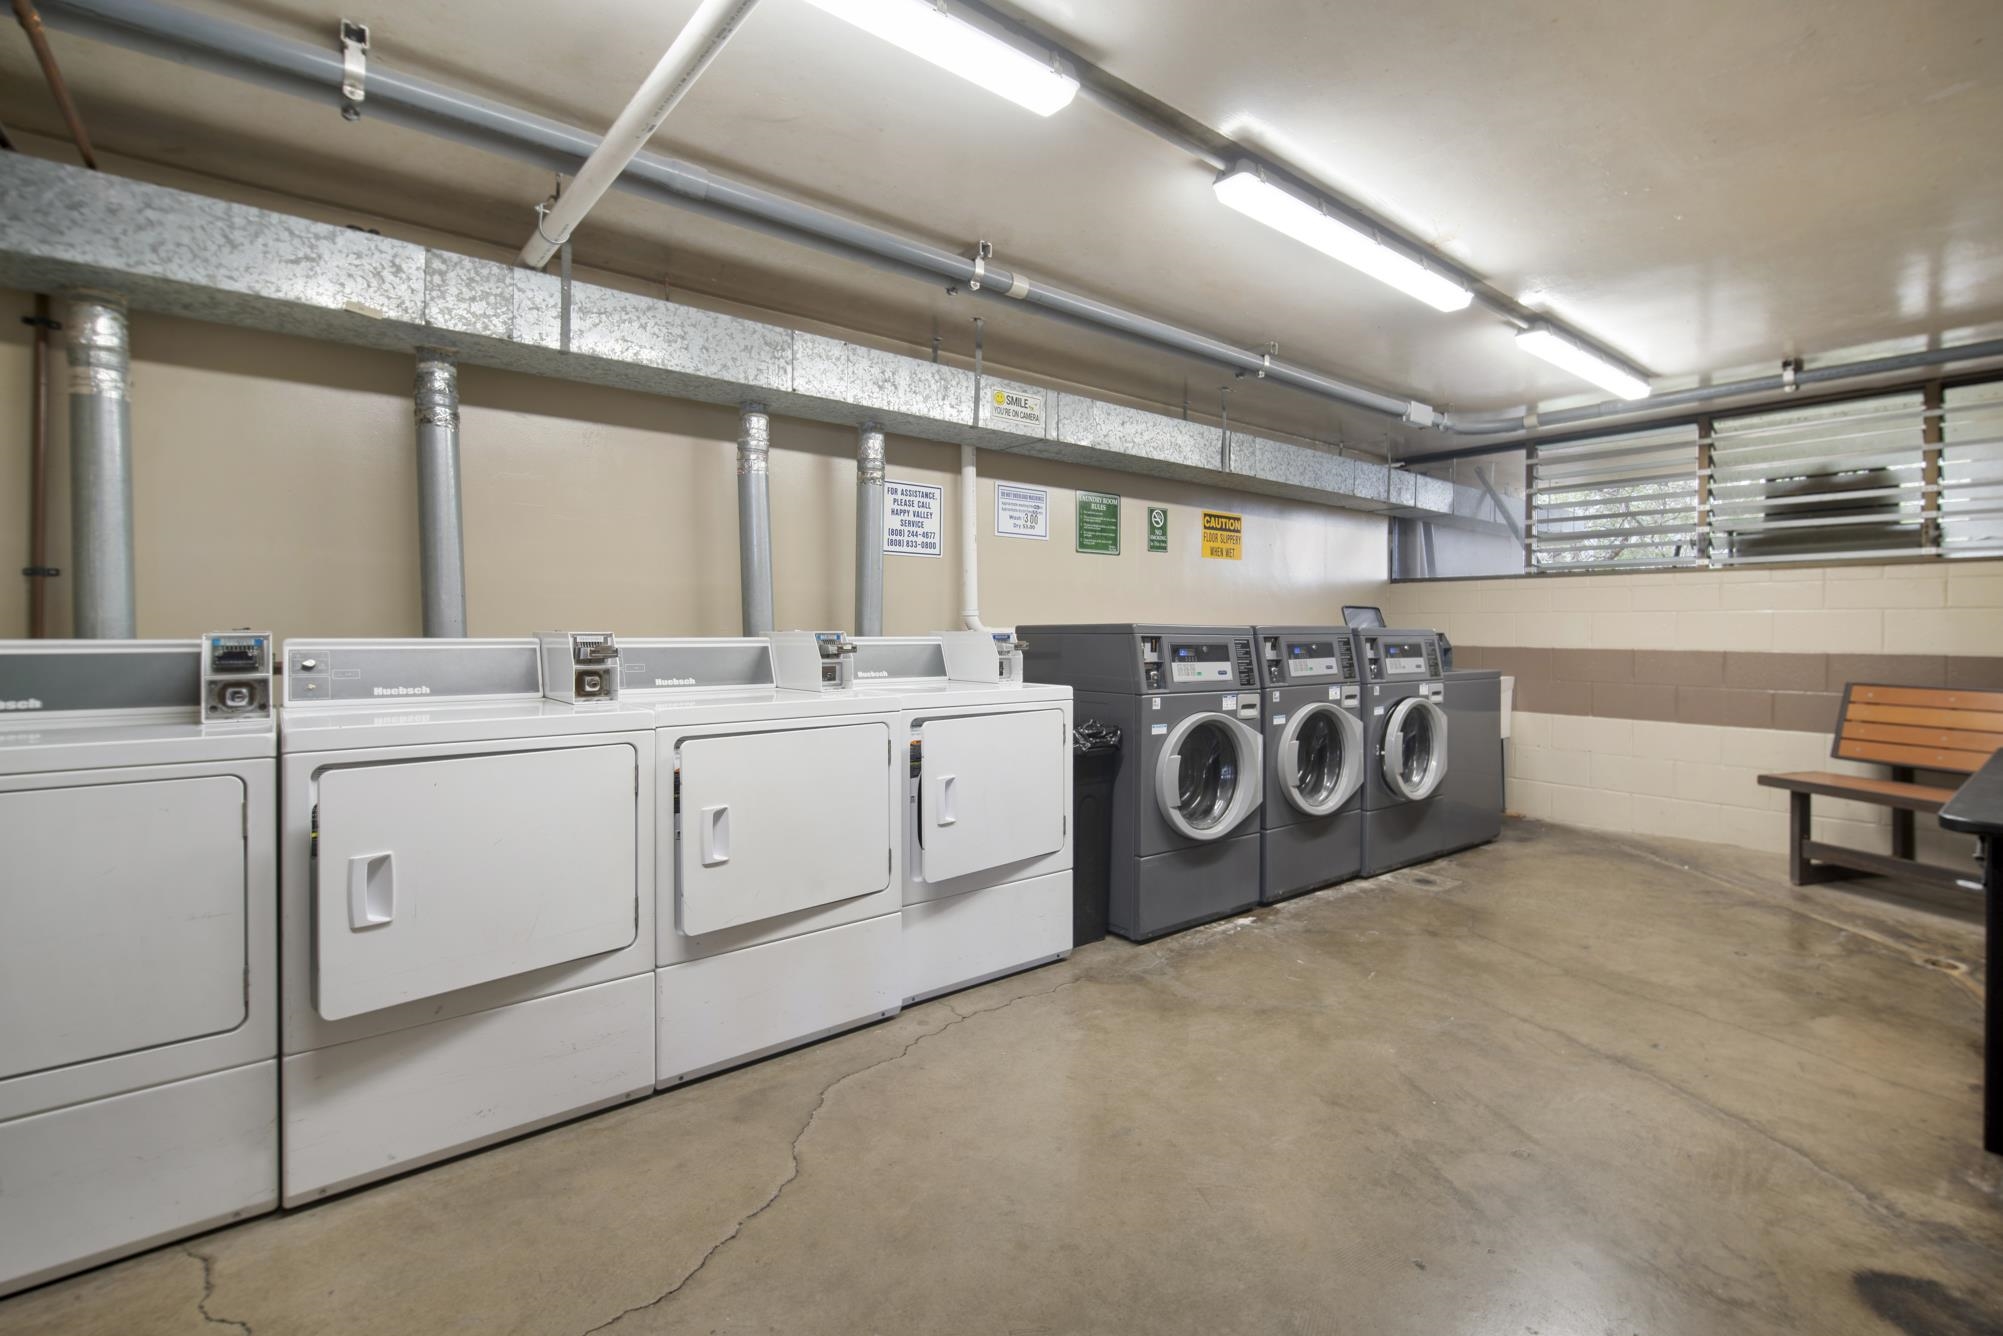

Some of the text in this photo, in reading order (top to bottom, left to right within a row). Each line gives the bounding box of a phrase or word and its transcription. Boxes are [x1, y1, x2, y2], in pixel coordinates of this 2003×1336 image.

[1006, 395, 1029, 409] SMILE
[994, 406, 1039, 421] YOU'RE ON CAMERA
[887, 487, 898, 496] FOR
[893, 498, 931, 509] PLEASE CALL
[1080, 495, 1102, 504] LAUNDRY
[891, 508, 933, 519] HAPPY VALLEY
[900, 519, 924, 528] SERVICE
[1204, 516, 1240, 530] CAUTION
[888, 528, 905, 537] (808)
[887, 538, 936, 549] (808) 833-0800
[1204, 532, 1241, 545] FLOOR SLIPPERY
[1210, 546, 1235, 558] WHEN WET
[373, 686, 430, 696] Huebsch
